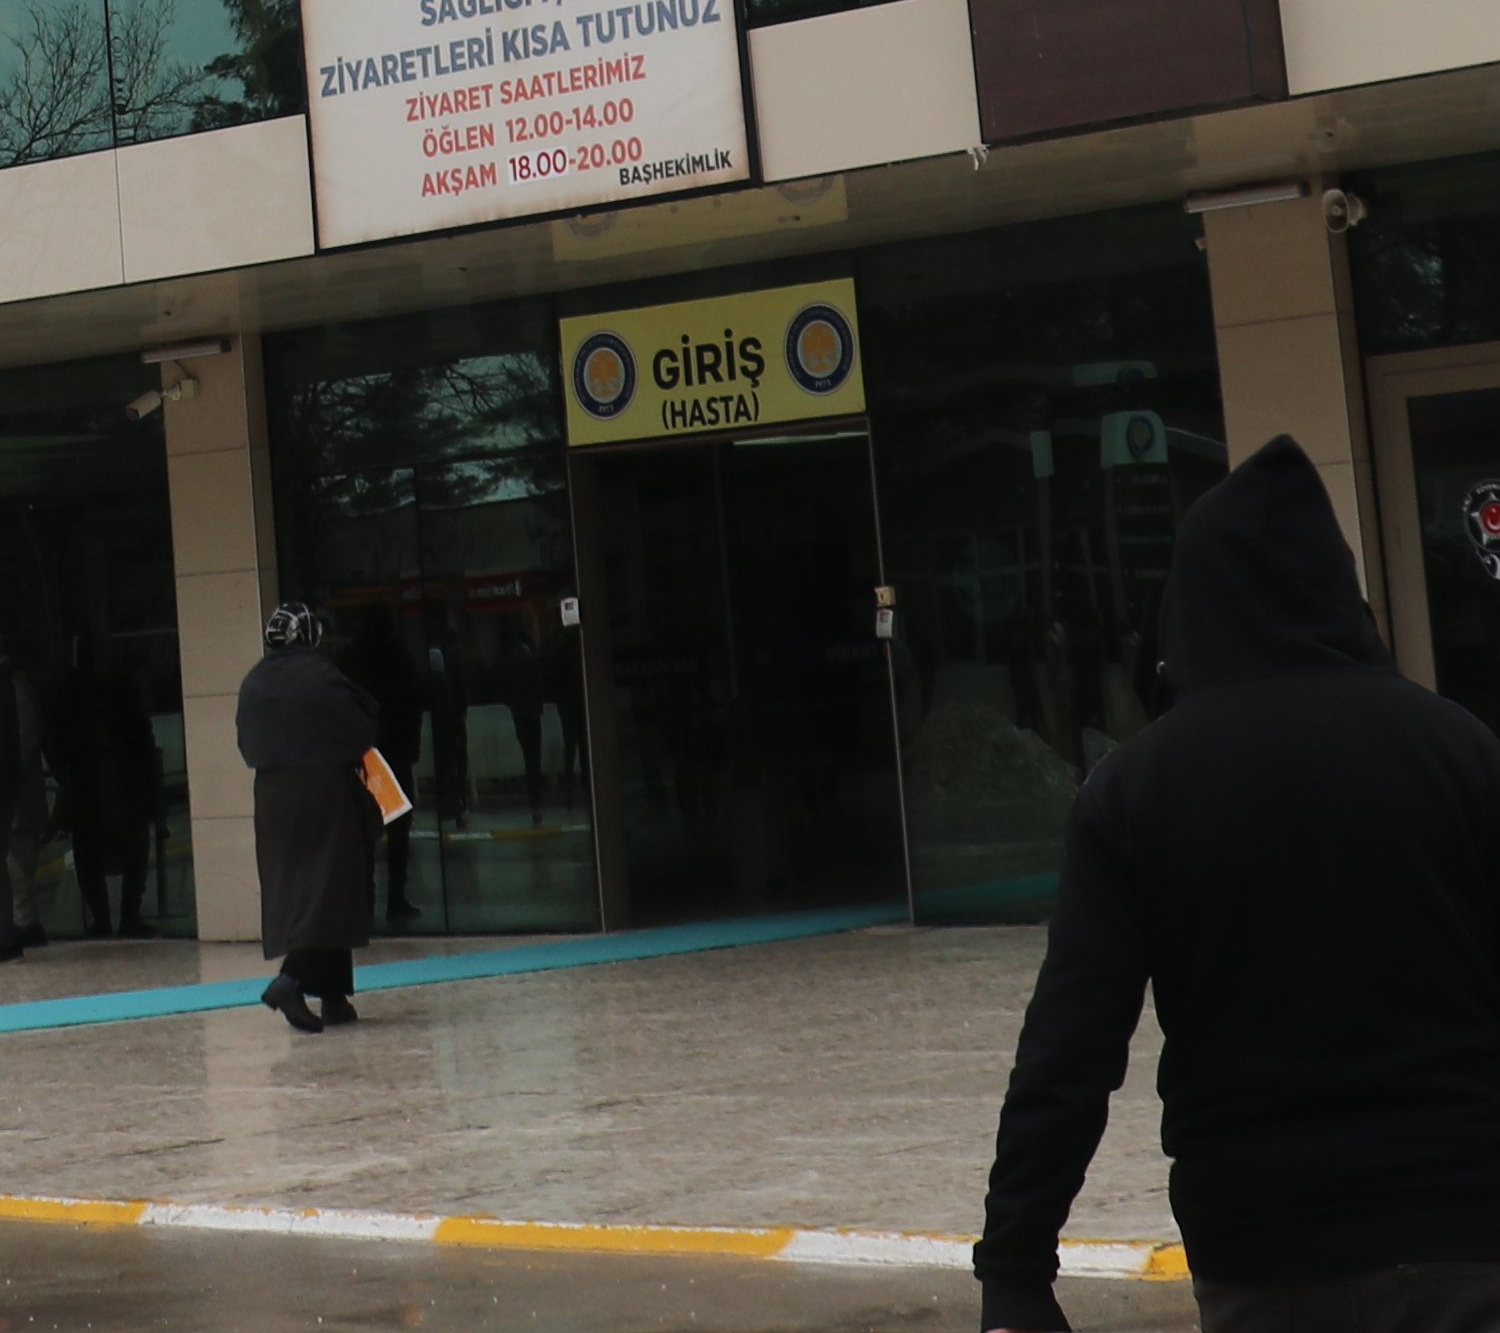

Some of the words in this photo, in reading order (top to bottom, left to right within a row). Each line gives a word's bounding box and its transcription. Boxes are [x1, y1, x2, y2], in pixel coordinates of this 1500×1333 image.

[319, 34, 496, 98] ZİYARETLERİ
[501, 19, 570, 64] KISA
[406, 83, 494, 122] ZİYARET
[500, 54, 646, 104] SAATLERİMİZ
[421, 123, 496, 158] ÖĞLEN
[505, 97, 635, 142] 12.00-14.00
[420, 162, 498, 198] AKŞAM
[508, 137, 643, 182] 18.00-20.00
[618, 149, 733, 187] BAŞHEKİMLİK
[652, 328, 765, 390] GİRİŞ
[662, 391, 760, 430] (HASTA)
